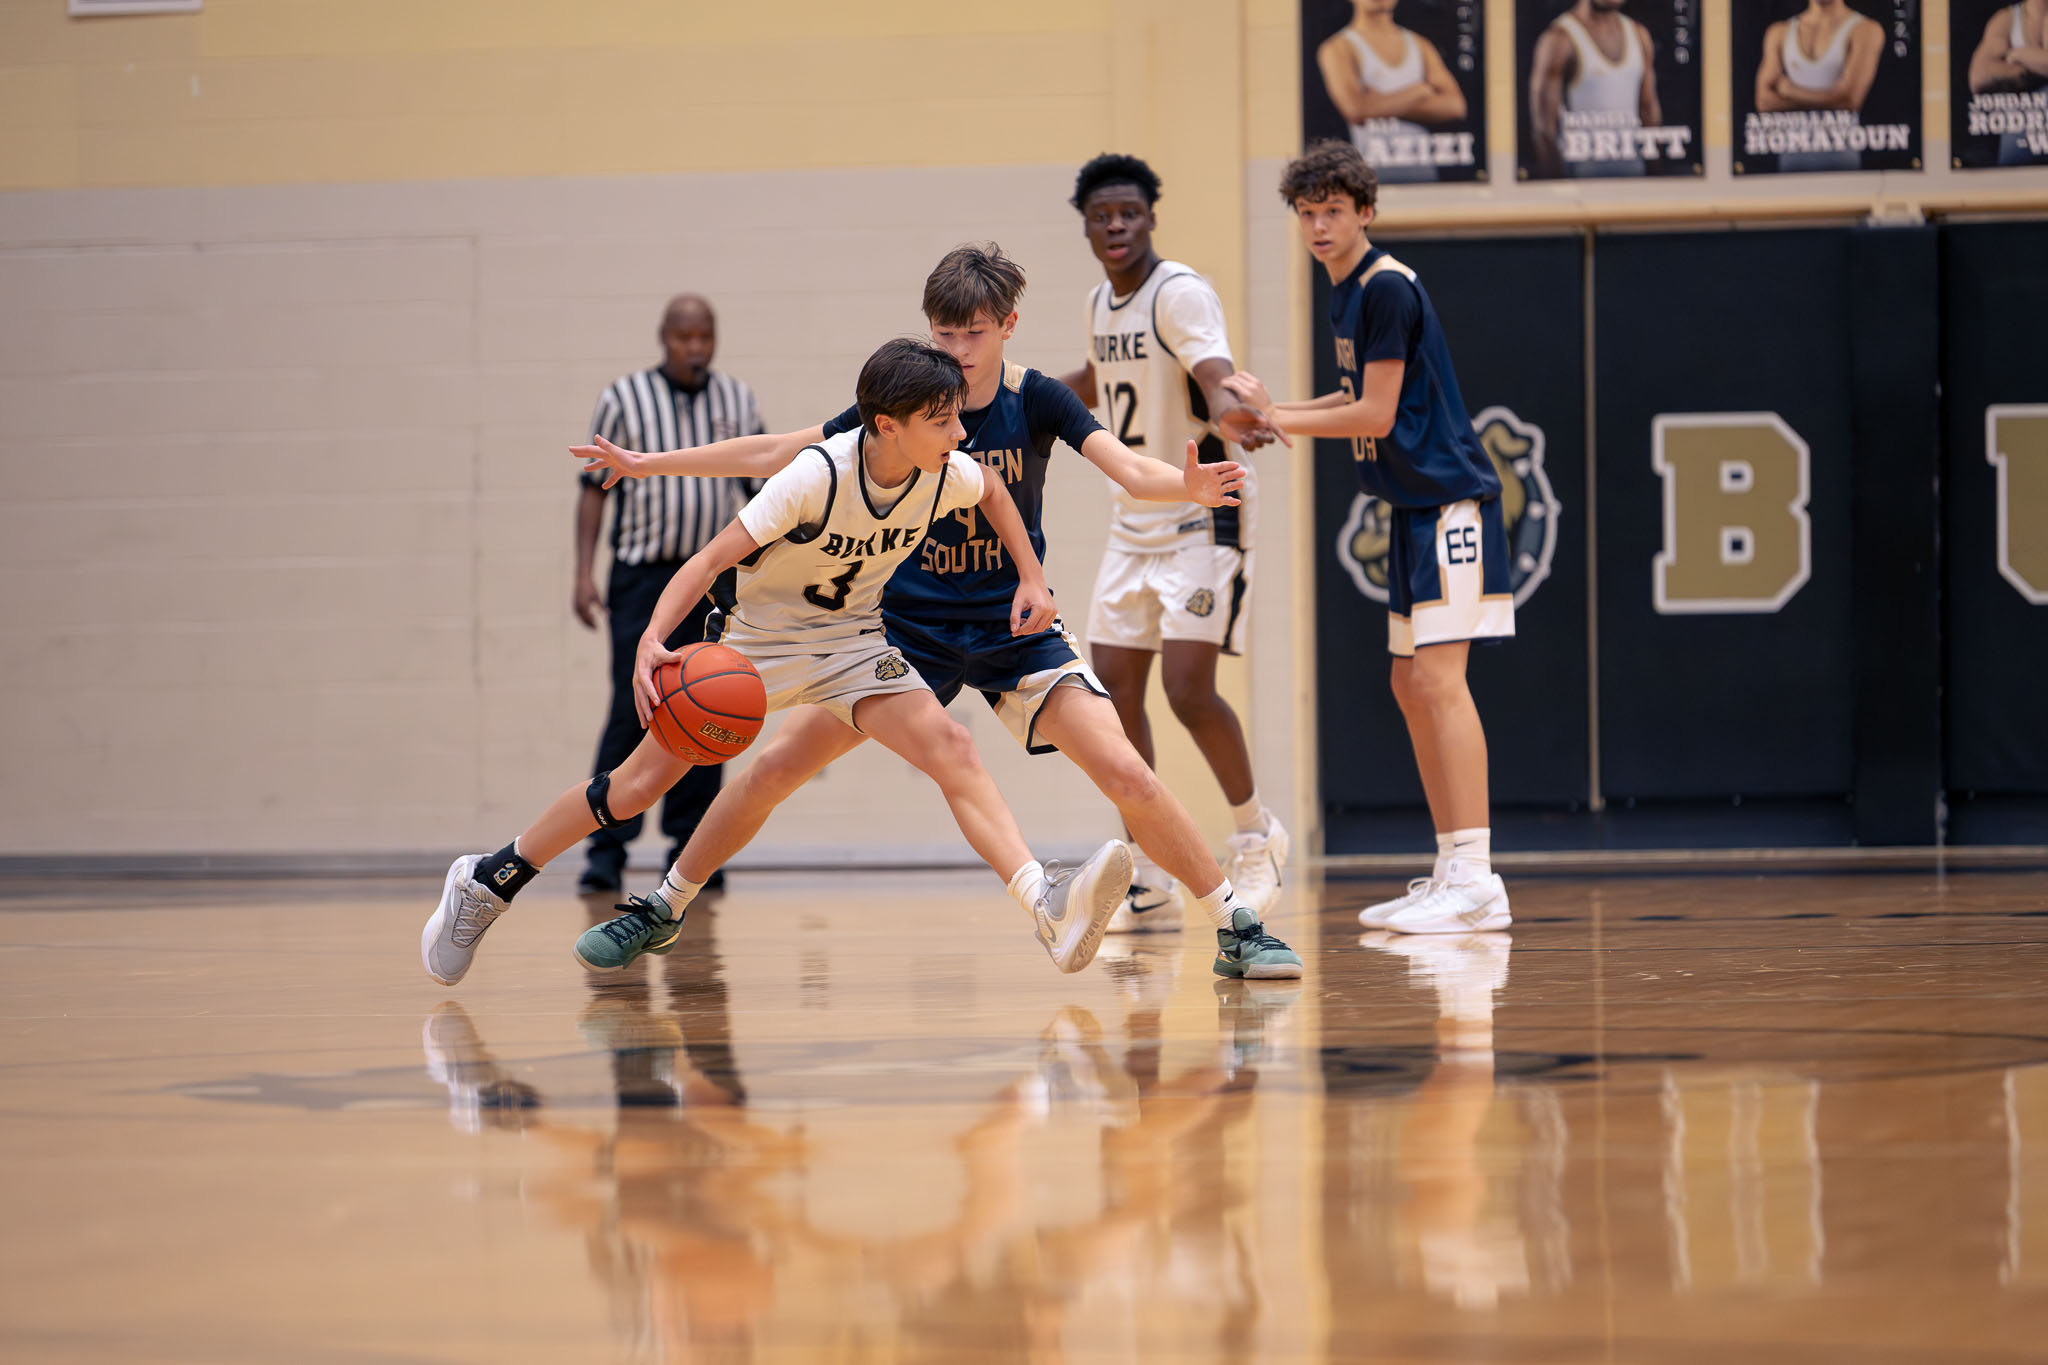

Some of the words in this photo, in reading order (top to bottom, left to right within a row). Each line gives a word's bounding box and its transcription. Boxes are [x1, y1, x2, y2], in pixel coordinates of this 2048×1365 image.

[1745, 124, 1910, 154] HOMAYOUN
[1968, 111, 2048, 136] RODR
[1363, 131, 1475, 167] AZIZI
[1563, 125, 1692, 161] BRITT
[920, 536, 1003, 575] SOUTH
[1445, 526, 1477, 565] ES
[801, 559, 865, 613] 3
